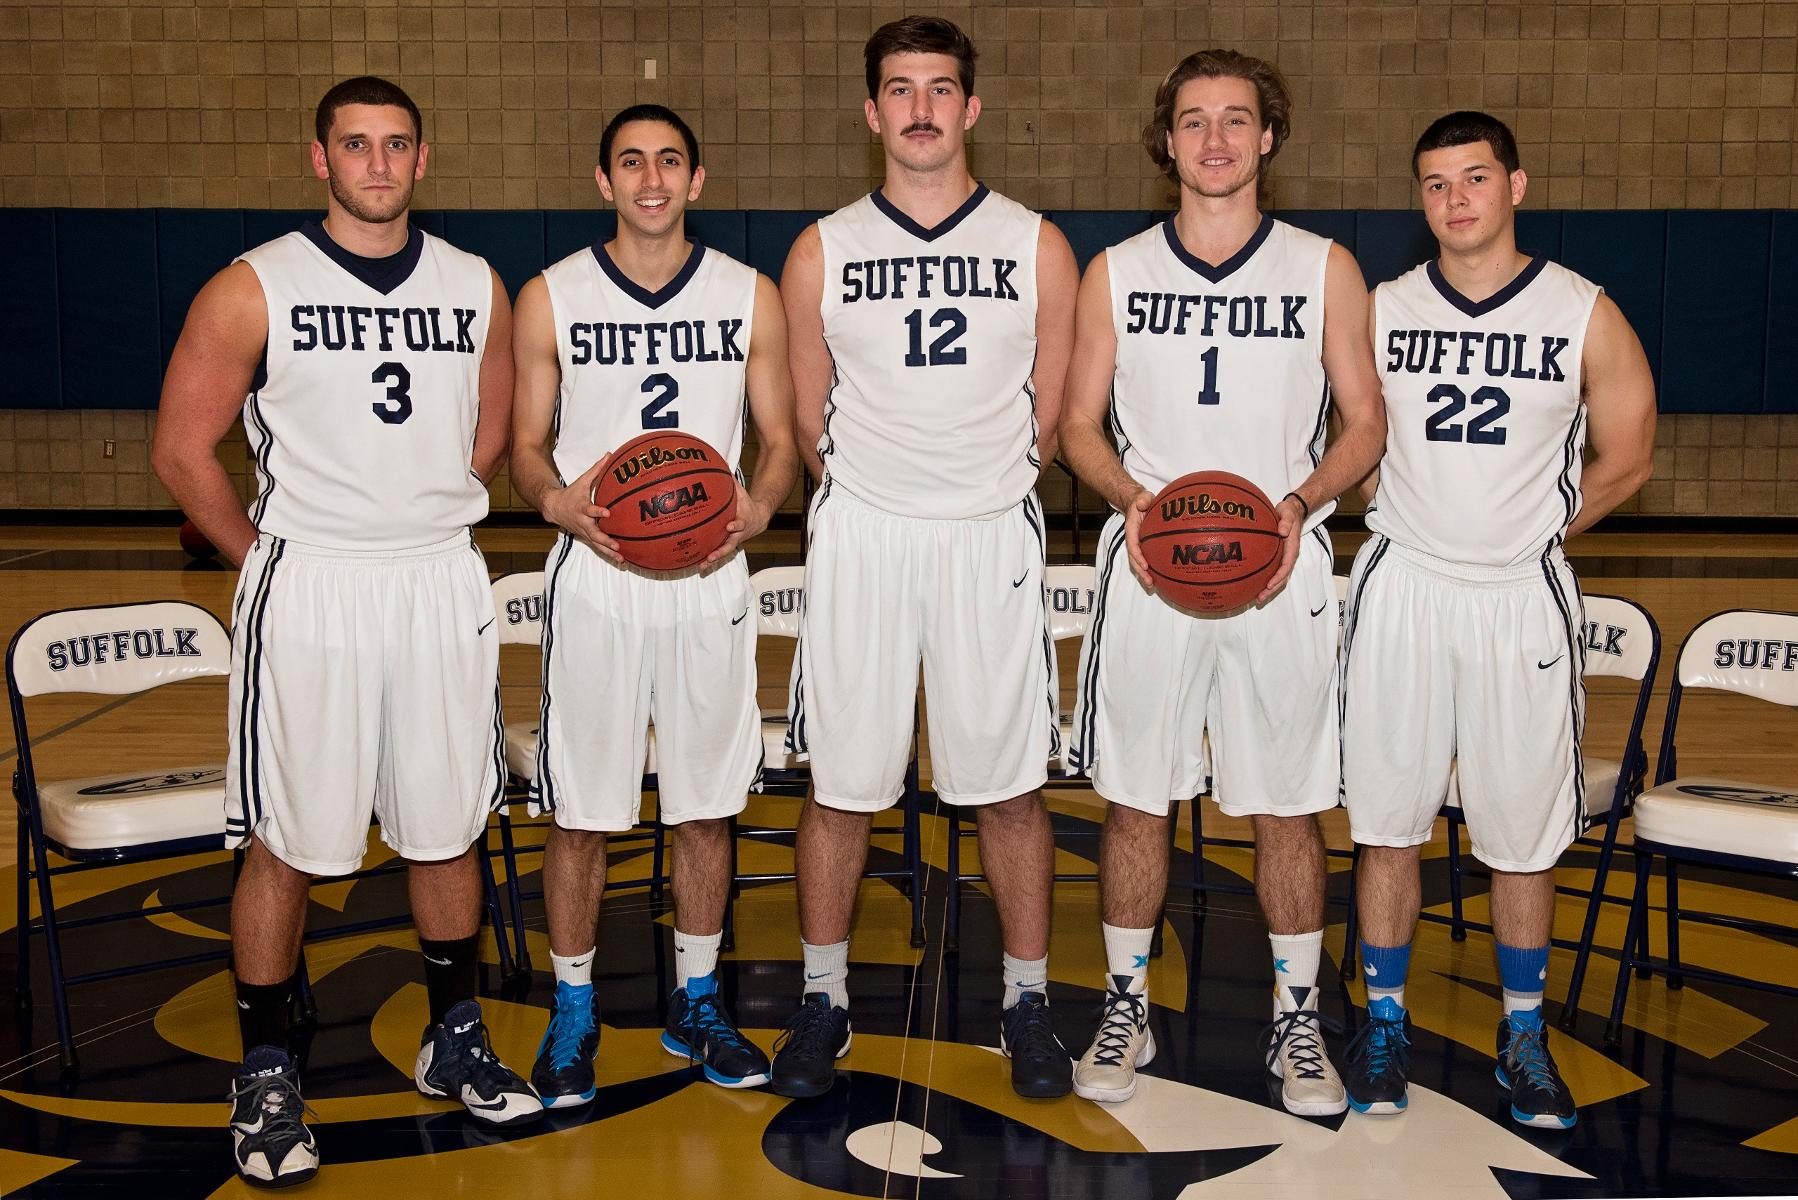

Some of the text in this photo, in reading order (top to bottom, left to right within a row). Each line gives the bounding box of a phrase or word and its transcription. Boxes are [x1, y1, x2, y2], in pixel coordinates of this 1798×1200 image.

[842, 255, 1019, 304] SUFFOLK
[291, 305, 476, 354] SUFFOLK
[904, 307, 967, 367] 12
[1126, 291, 1307, 339] SUFFOLK
[569, 318, 744, 365] SUFFOLK
[1386, 329, 1569, 382] SUFFOLK
[371, 361, 412, 425] 3
[1197, 346, 1220, 405] 1
[640, 372, 679, 430] 2
[1425, 383, 1511, 445] 22
[612, 447, 708, 485] Wilson
[638, 481, 709, 522] NCAA
[1160, 493, 1256, 522] Wilson
[1171, 541, 1243, 565] NCAA
[1046, 587, 1095, 614] OL
[46, 628, 201, 672] SUFFOLK
[1584, 621, 1628, 657] LK
[1713, 638, 1798, 672] SUFF
